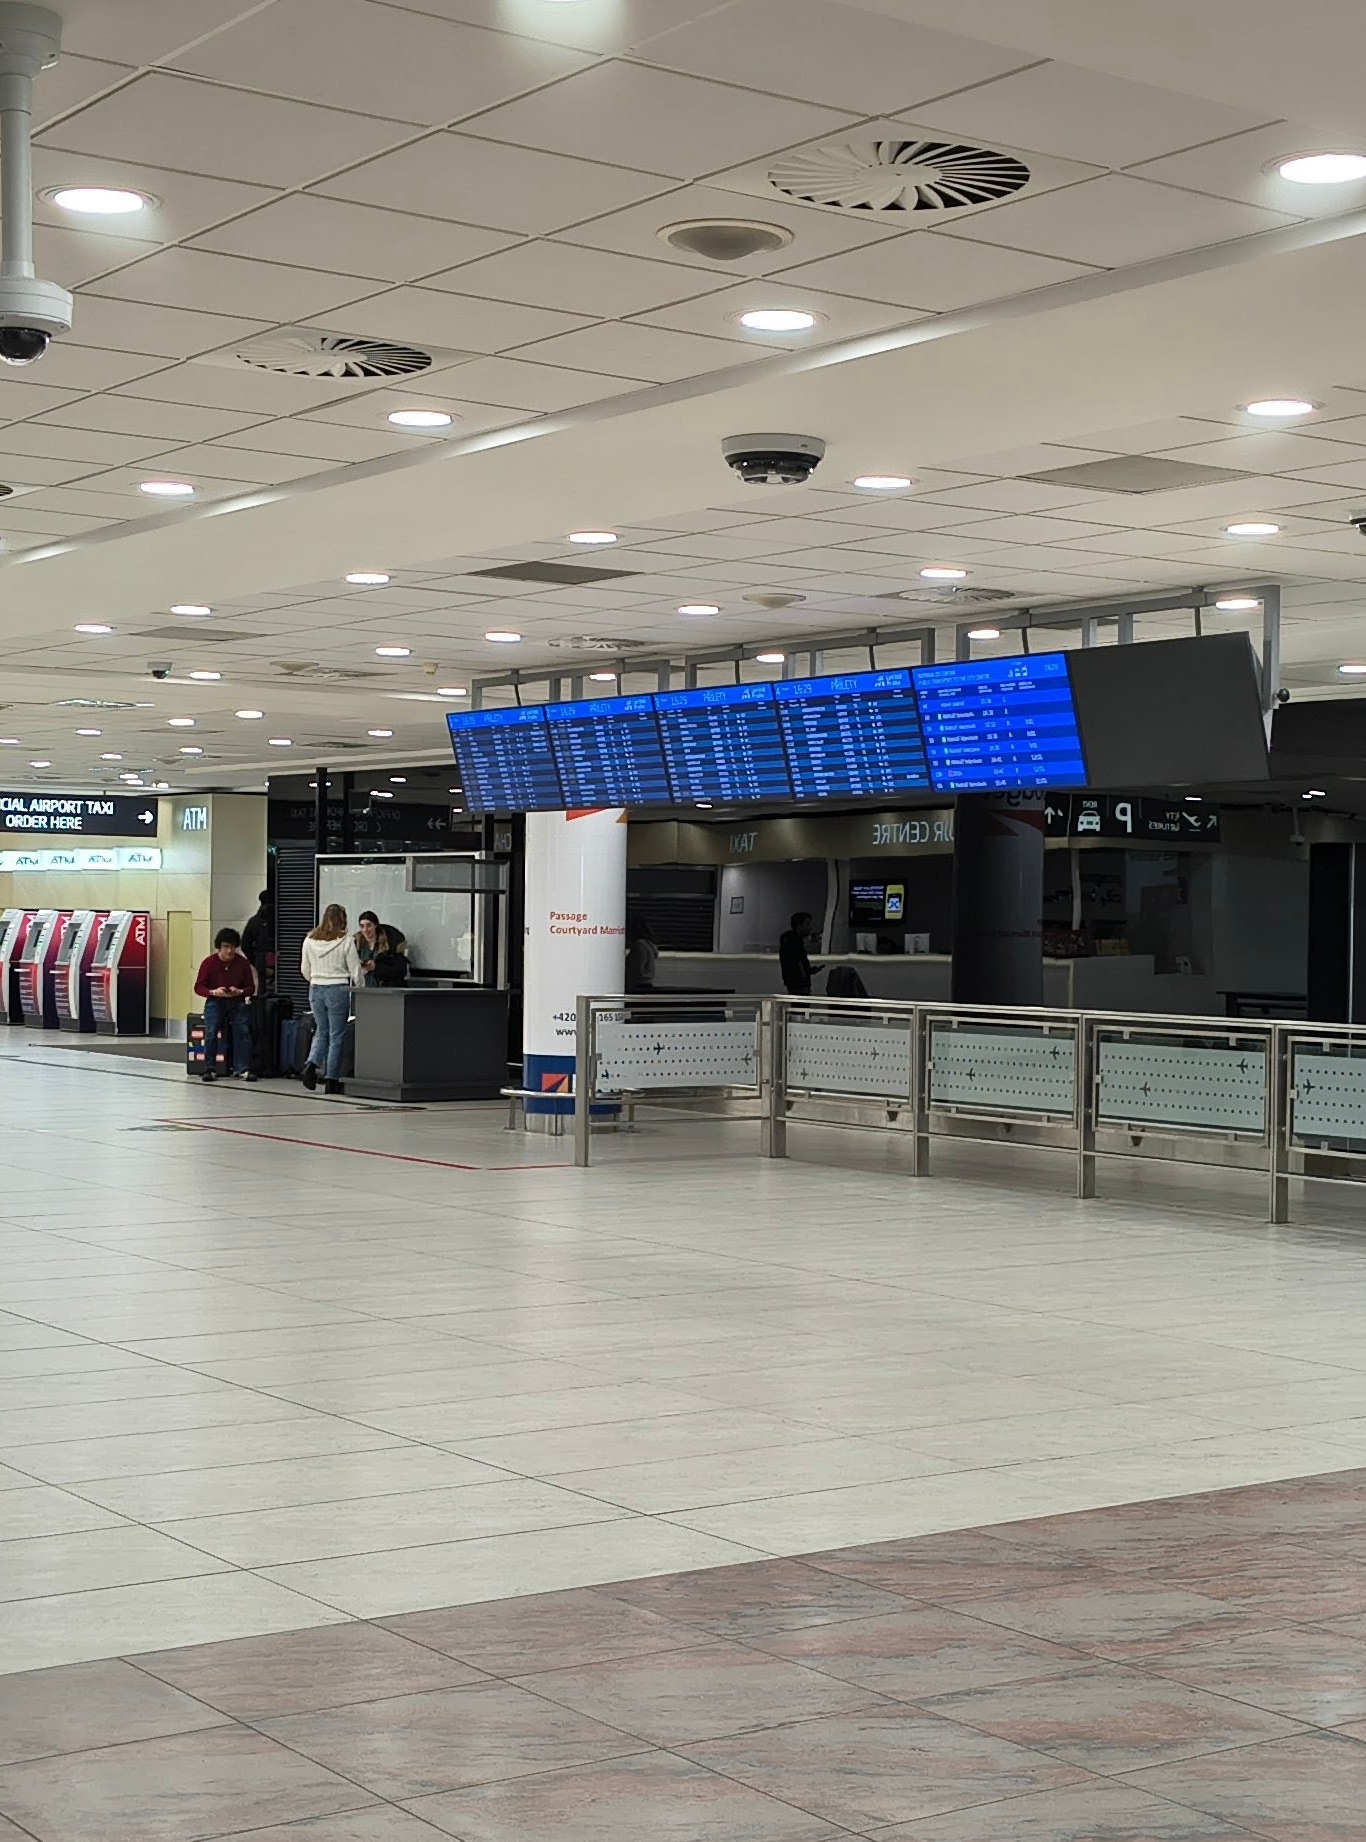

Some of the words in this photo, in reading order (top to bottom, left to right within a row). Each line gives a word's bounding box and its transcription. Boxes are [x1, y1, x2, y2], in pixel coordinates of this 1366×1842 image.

[29, 798, 84, 814] AIRPORT
[85, 800, 114, 815] TAXI
[6, 815, 48, 829] ORDER
[50, 816, 83, 830] HERE
[183, 807, 208, 831] ATM
[549, 911, 588, 923] Passage
[135, 916, 146, 945] ATM
[549, 925, 598, 937] Courtyard
